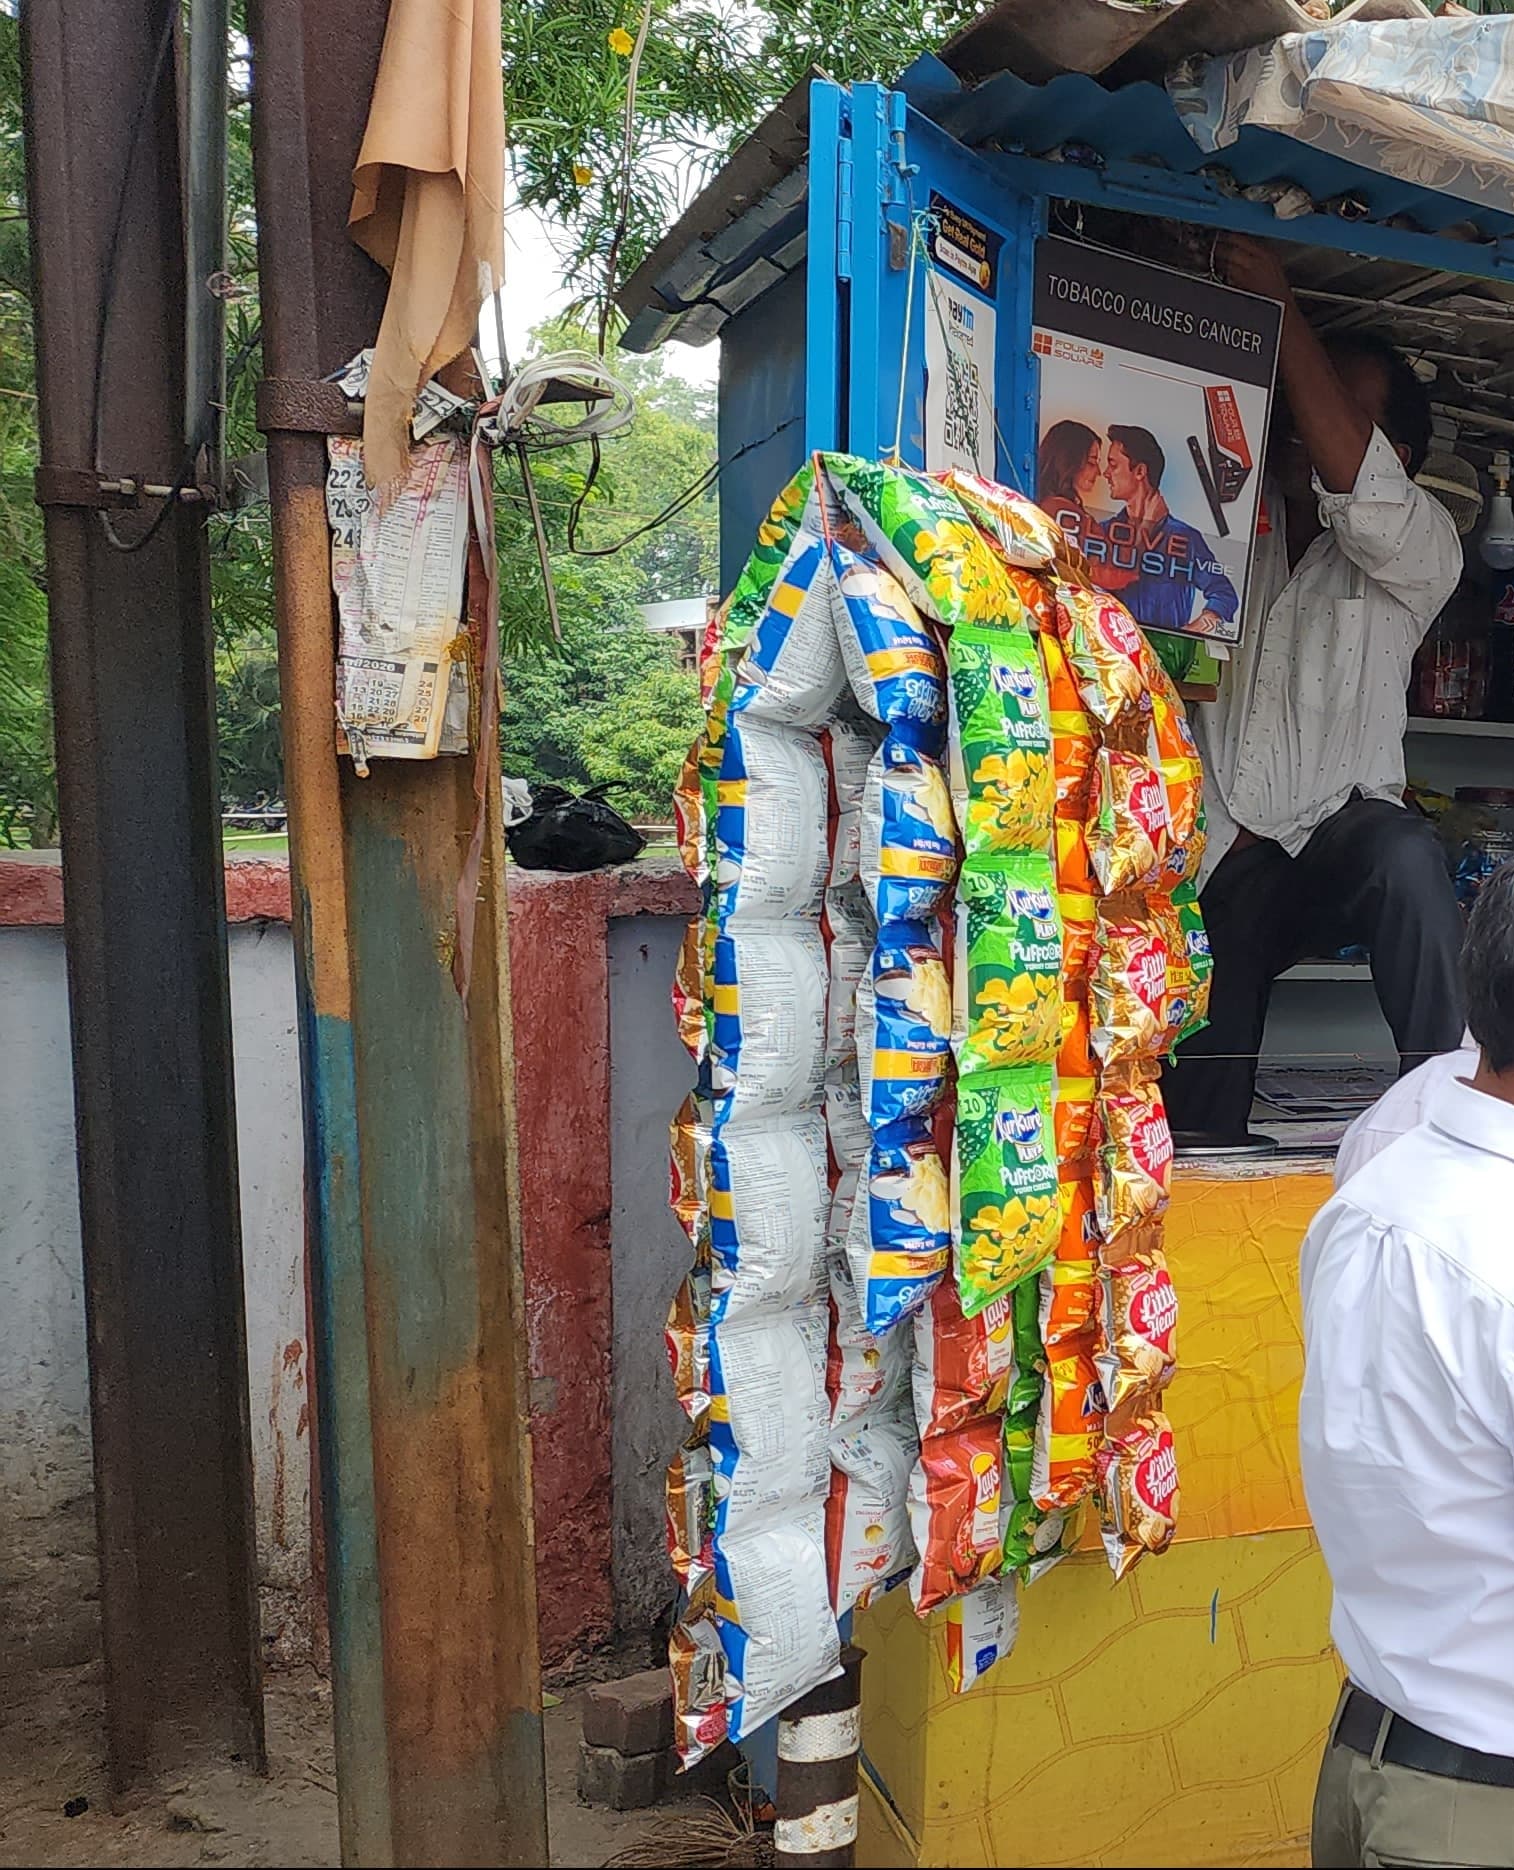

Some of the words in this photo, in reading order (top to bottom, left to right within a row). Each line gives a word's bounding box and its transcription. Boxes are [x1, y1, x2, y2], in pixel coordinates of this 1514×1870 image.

[1049, 275, 1125, 315] TOBACCO
[1130, 299, 1194, 335] CAUSES
[1199, 318, 1262, 354] CANCER
[967, 876, 988, 892] 10
[964, 1097, 981, 1114] 10
